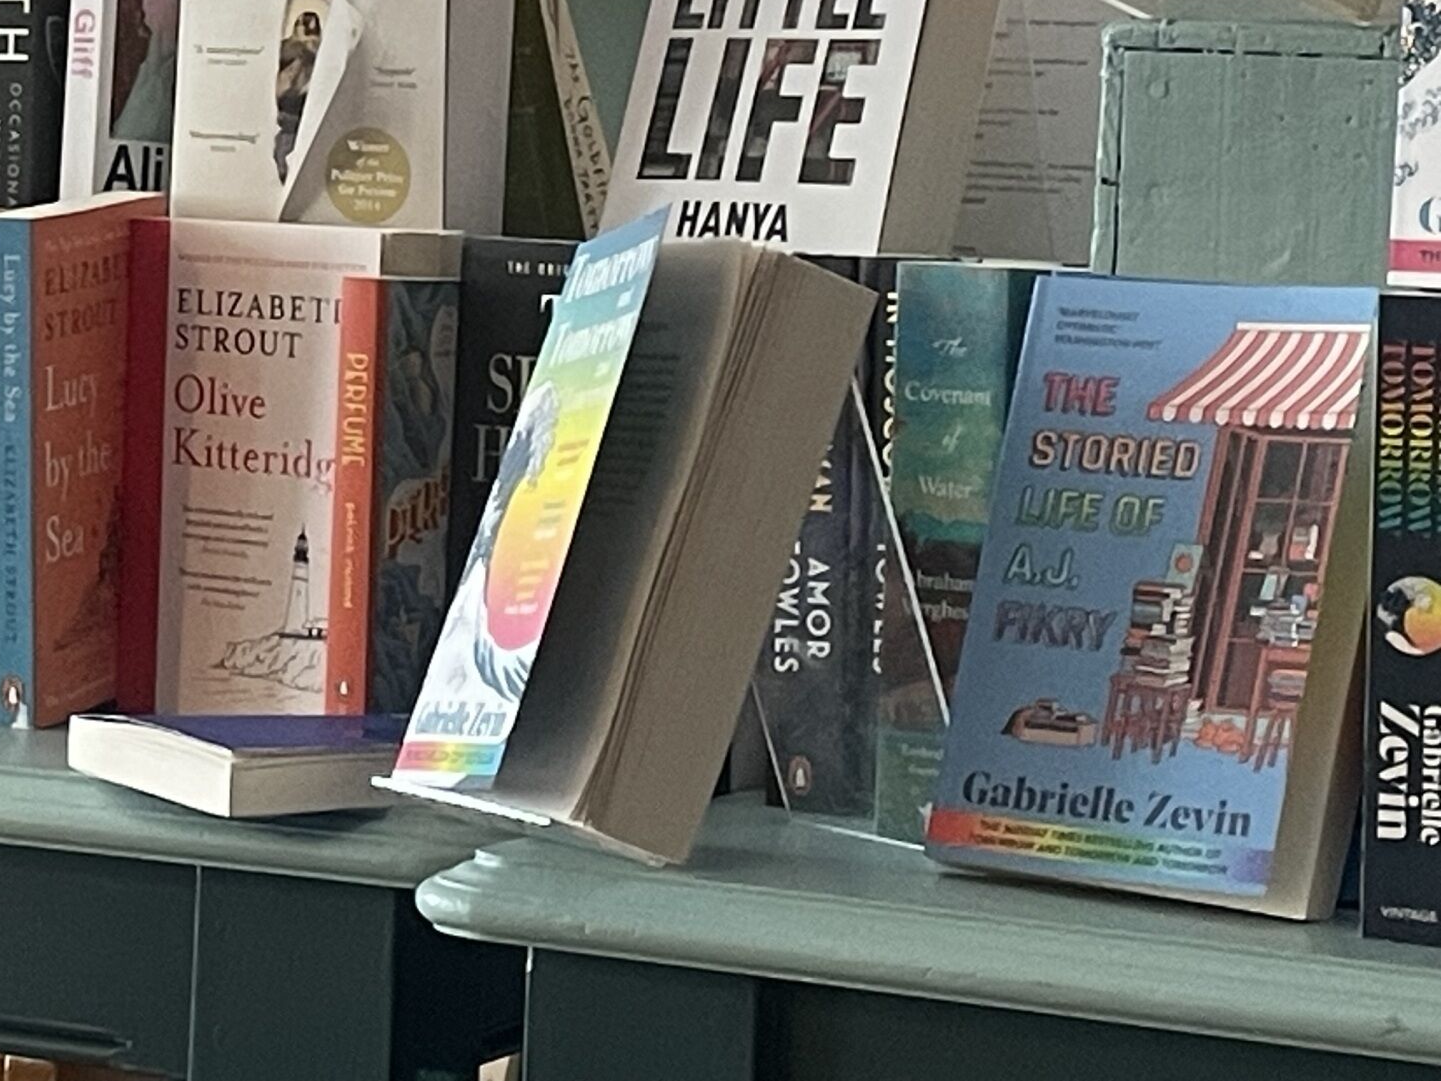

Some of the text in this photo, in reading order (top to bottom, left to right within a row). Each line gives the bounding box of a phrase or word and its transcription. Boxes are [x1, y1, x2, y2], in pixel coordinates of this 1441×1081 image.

[71, 8, 97, 80] Gliff
[636, 37, 882, 186] LIFE
[102, 144, 163, 192] Ali
[676, 200, 789, 243] HANYA
[2, 342, 21, 378] the
[175, 326, 302, 359] STROUT
[2, 383, 21, 423] Sea
[45, 365, 98, 414] Lucy
[174, 374, 266, 420] Olive
[342, 352, 369, 468] PERFUME
[905, 381, 992, 407] Covenant
[1044, 371, 1121, 417] THE
[45, 436, 112, 494] by the
[1030, 431, 1201, 480] STORIED
[918, 473, 974, 500] Water
[1020, 487, 1165, 535] LIFE OF
[45, 513, 85, 564] Sea
[1004, 544, 1080, 590] A.J.
[806, 556, 831, 661] AMOR
[993, 601, 1120, 652] FIKRY
[1376, 701, 1420, 840] Zevin
[962, 770, 1252, 838] Gabrielle Zevin
[1379, 903, 1437, 924] VINTAGE
